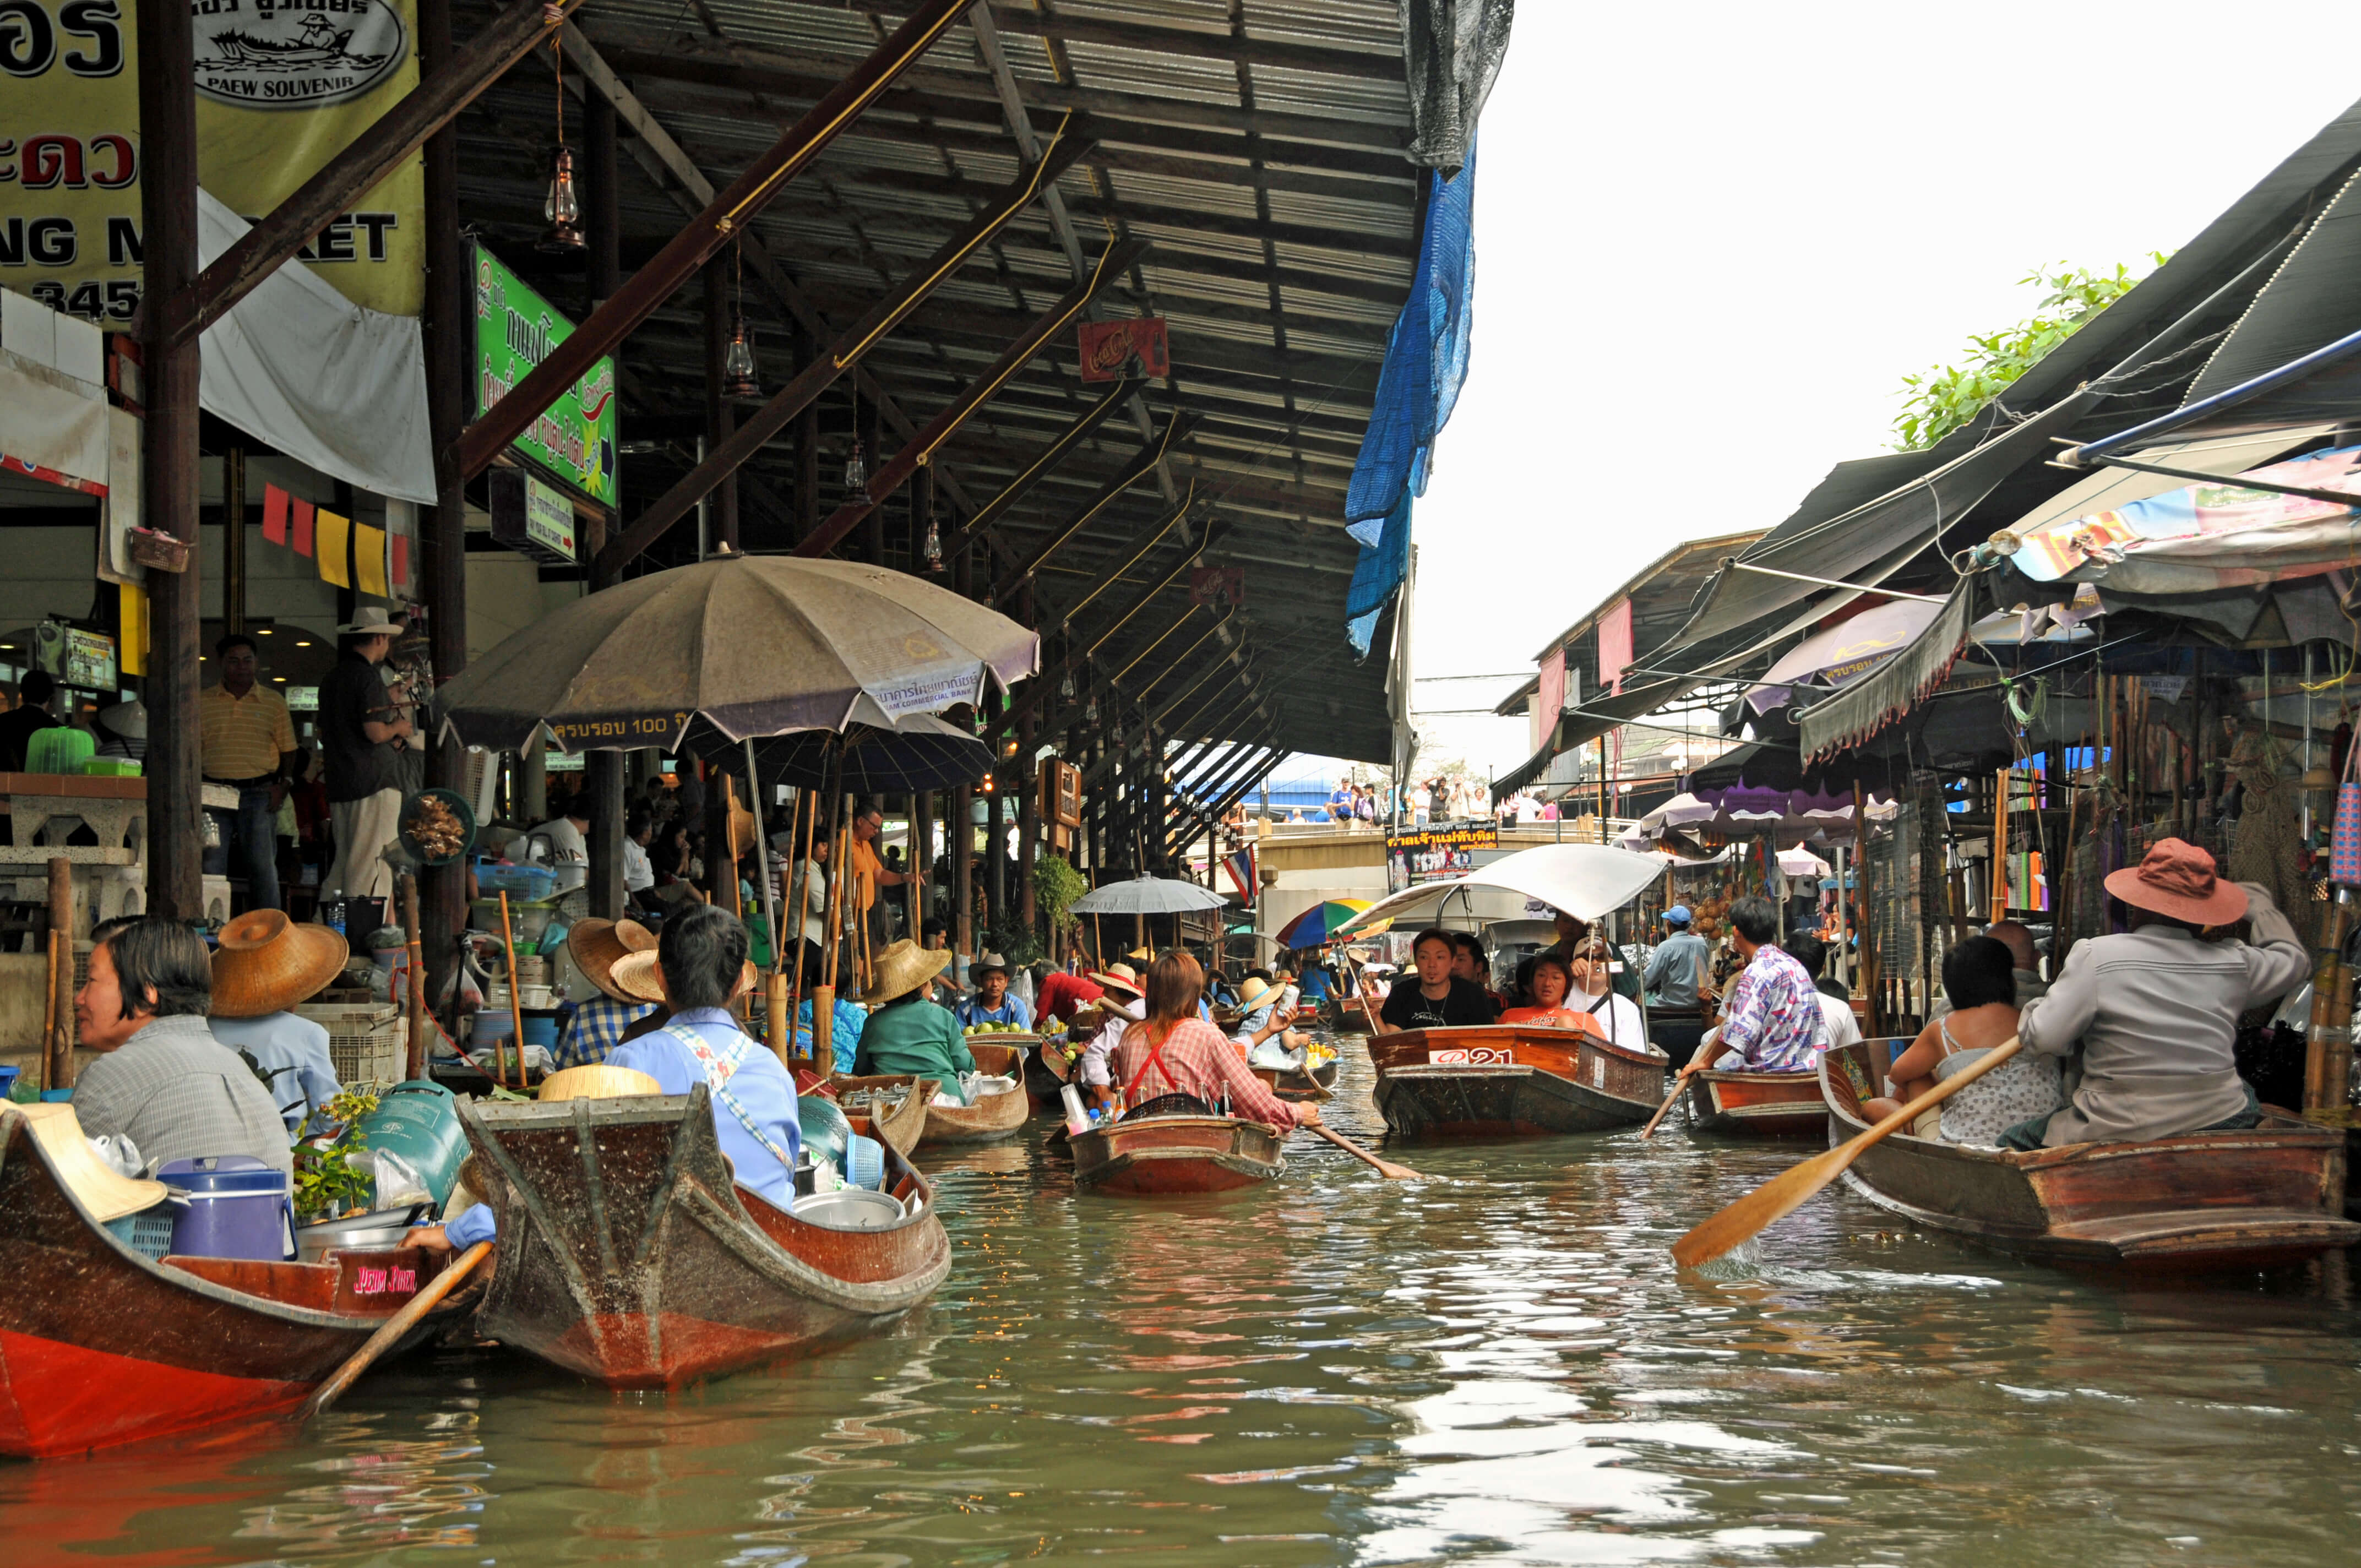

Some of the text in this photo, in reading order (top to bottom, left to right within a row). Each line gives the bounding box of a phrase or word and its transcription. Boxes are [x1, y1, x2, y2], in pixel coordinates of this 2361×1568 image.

[208, 76, 355, 97] PAEW SOUVENIR
[1089, 323, 1135, 373] Coca-Cola
[902, 693, 949, 708] COMMERCIAL
[951, 688, 973, 698] BANK
[554, 722, 626, 738] ครบรอบ
[632, 718, 667, 734] 100
[1470, 1047, 1513, 1064] 21
